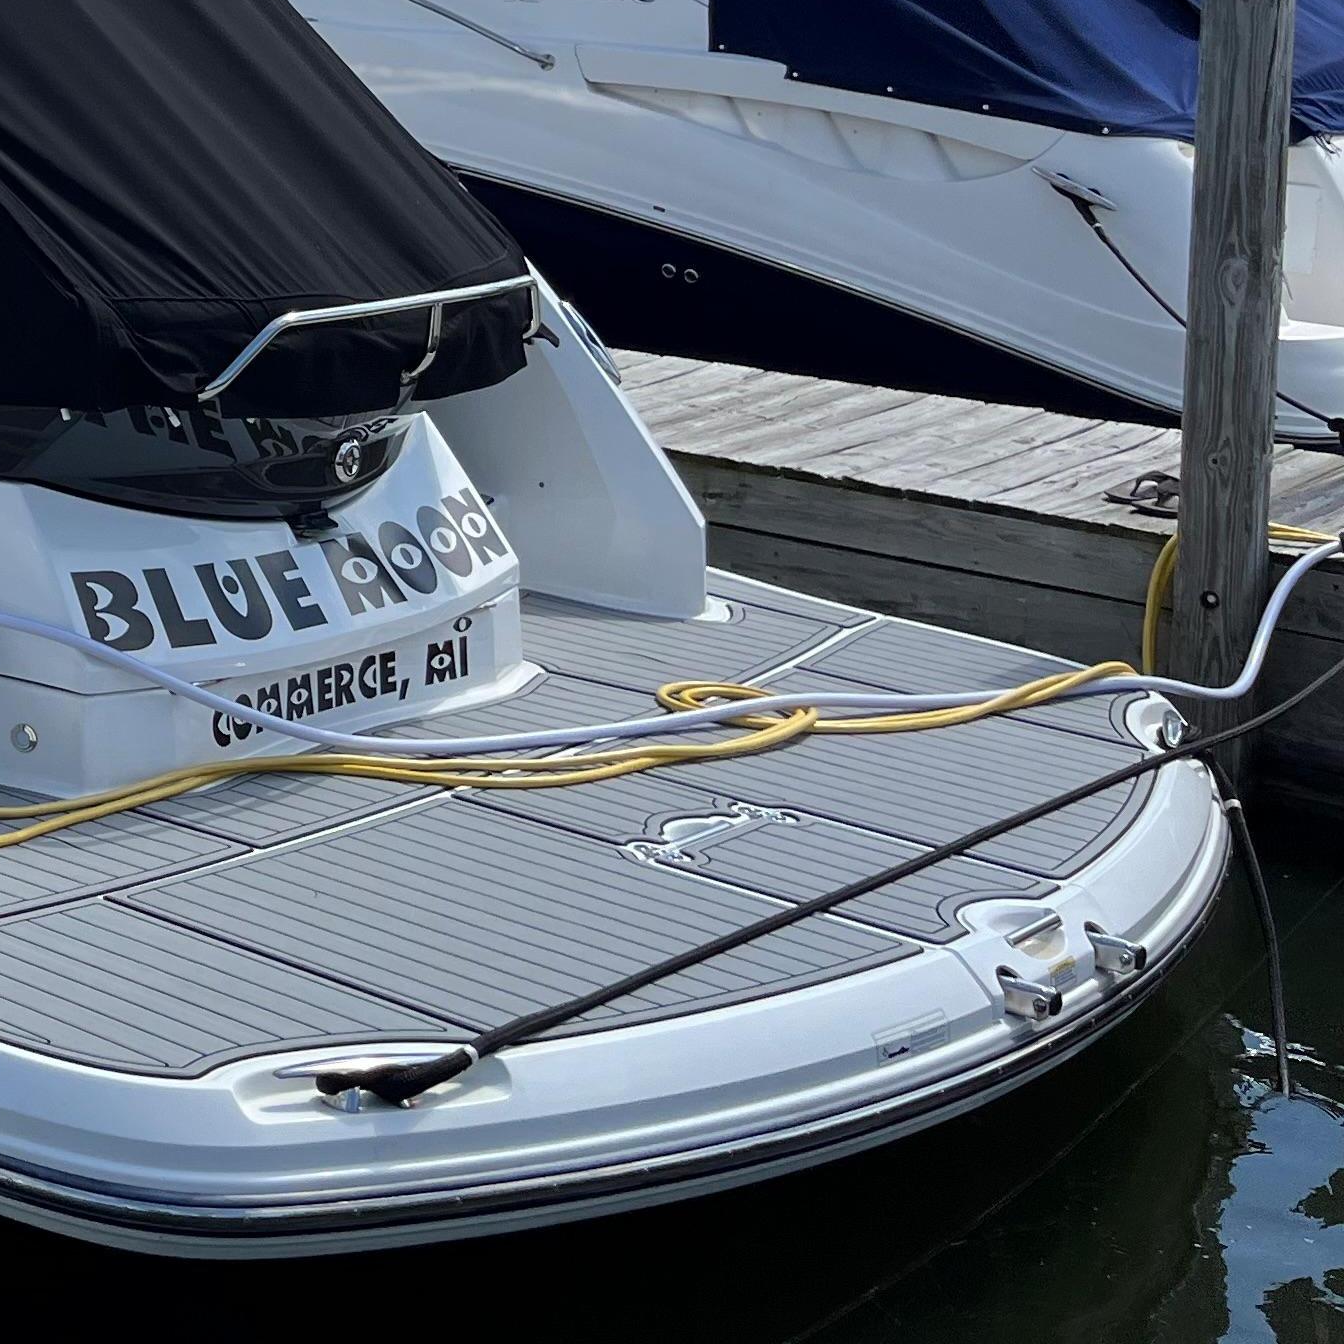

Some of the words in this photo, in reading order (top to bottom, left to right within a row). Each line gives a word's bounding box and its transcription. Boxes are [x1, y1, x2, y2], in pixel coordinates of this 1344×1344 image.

[70, 550, 329, 651] BLUE
[317, 487, 509, 616] MOON
[212, 651, 410, 747] COMMERCE,
